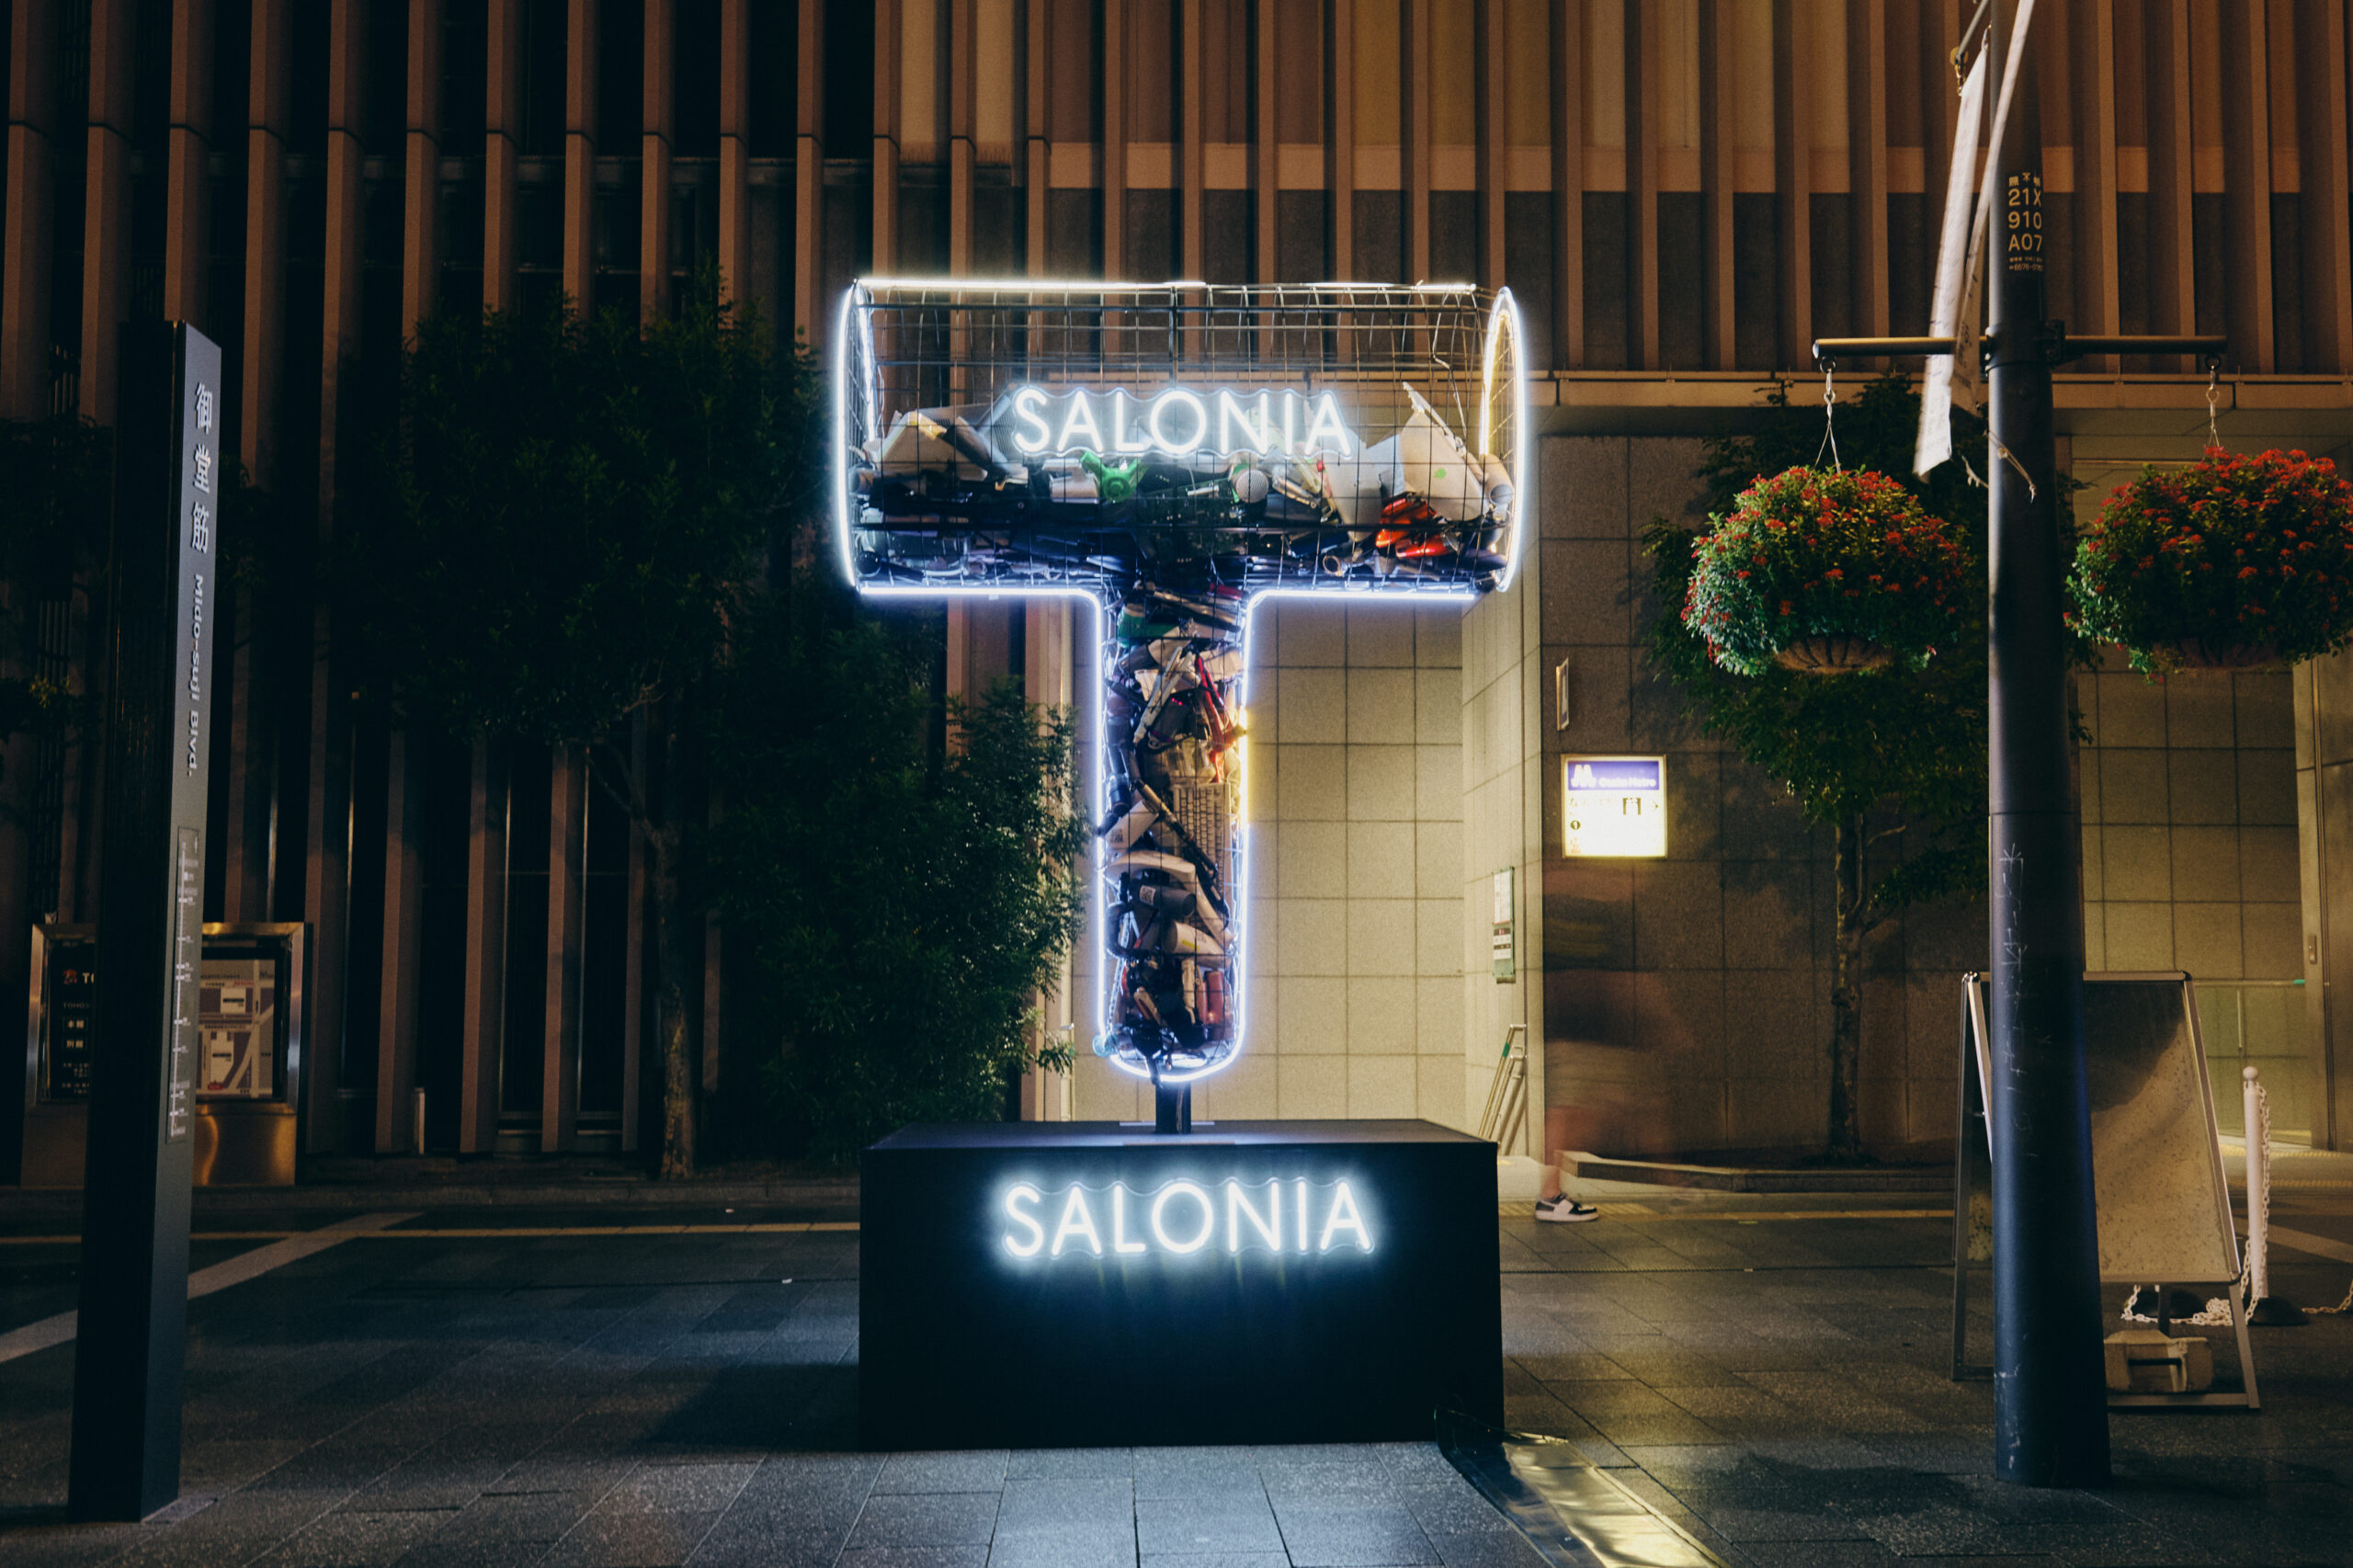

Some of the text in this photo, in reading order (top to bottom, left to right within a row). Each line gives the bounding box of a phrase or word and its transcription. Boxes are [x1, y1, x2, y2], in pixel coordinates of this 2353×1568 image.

[2008, 187, 2041, 206] 21X
[2008, 210, 2041, 229] 910
[1015, 388, 1352, 456] SALONIA
[192, 382, 213, 553] 御堂筋
[188, 574, 203, 778] Mido-suji Blvd.
[1006, 1182, 1371, 1256] SALONIA
